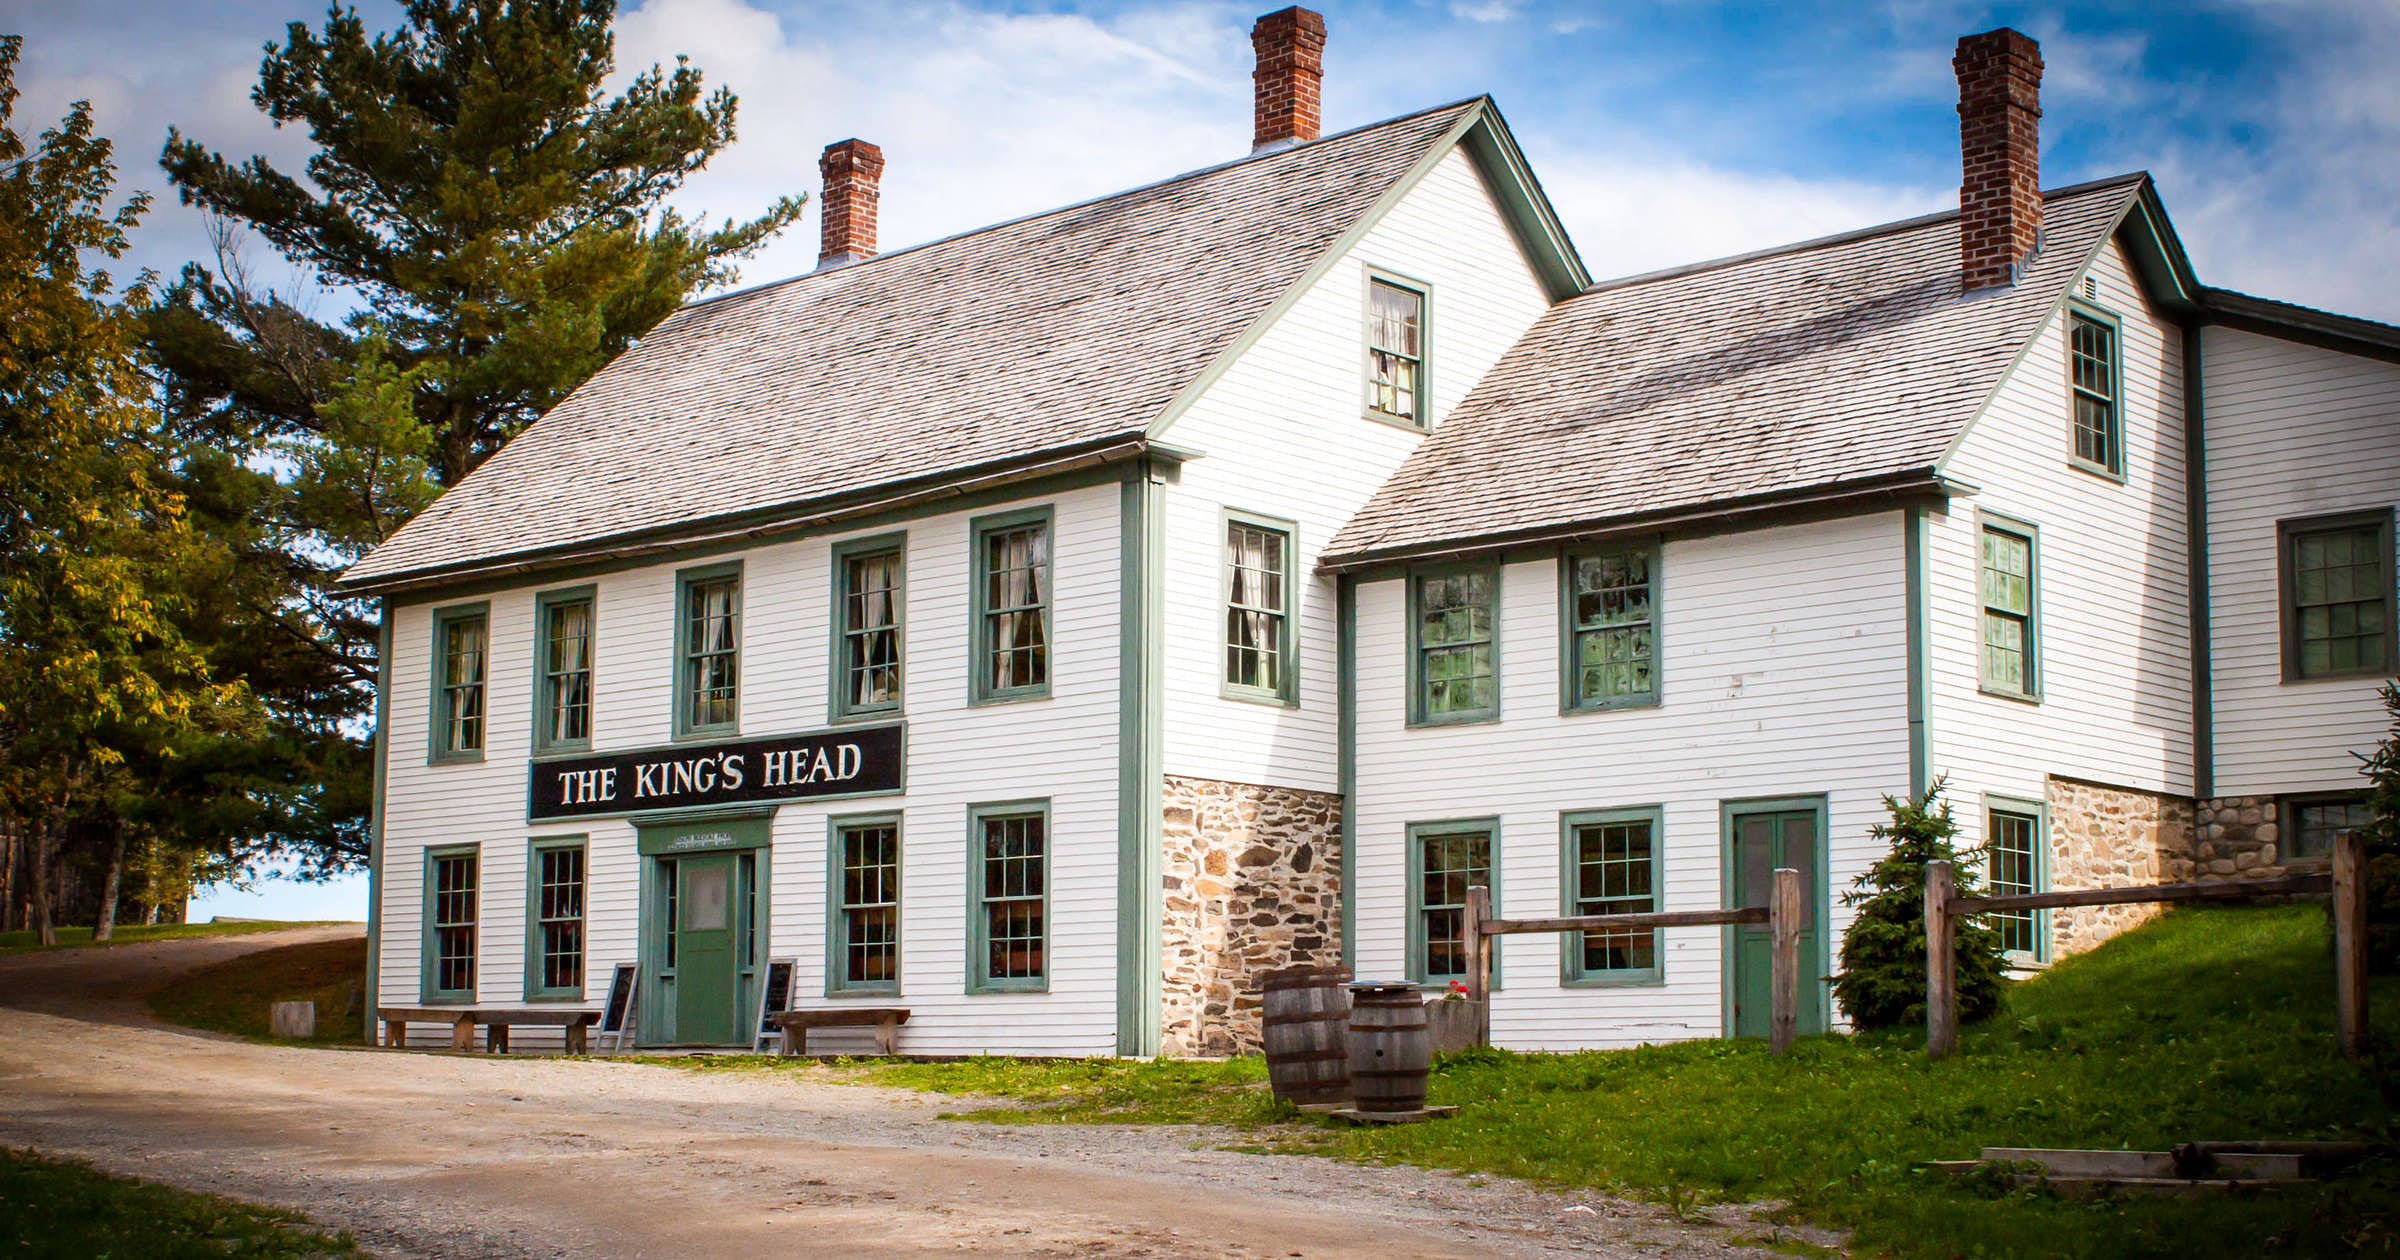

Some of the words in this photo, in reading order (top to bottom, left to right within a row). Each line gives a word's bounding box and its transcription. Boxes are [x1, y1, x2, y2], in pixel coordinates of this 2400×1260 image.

[558, 767, 617, 805] THE
[634, 751, 745, 798] KING'S
[762, 743, 862, 787] HEAD
